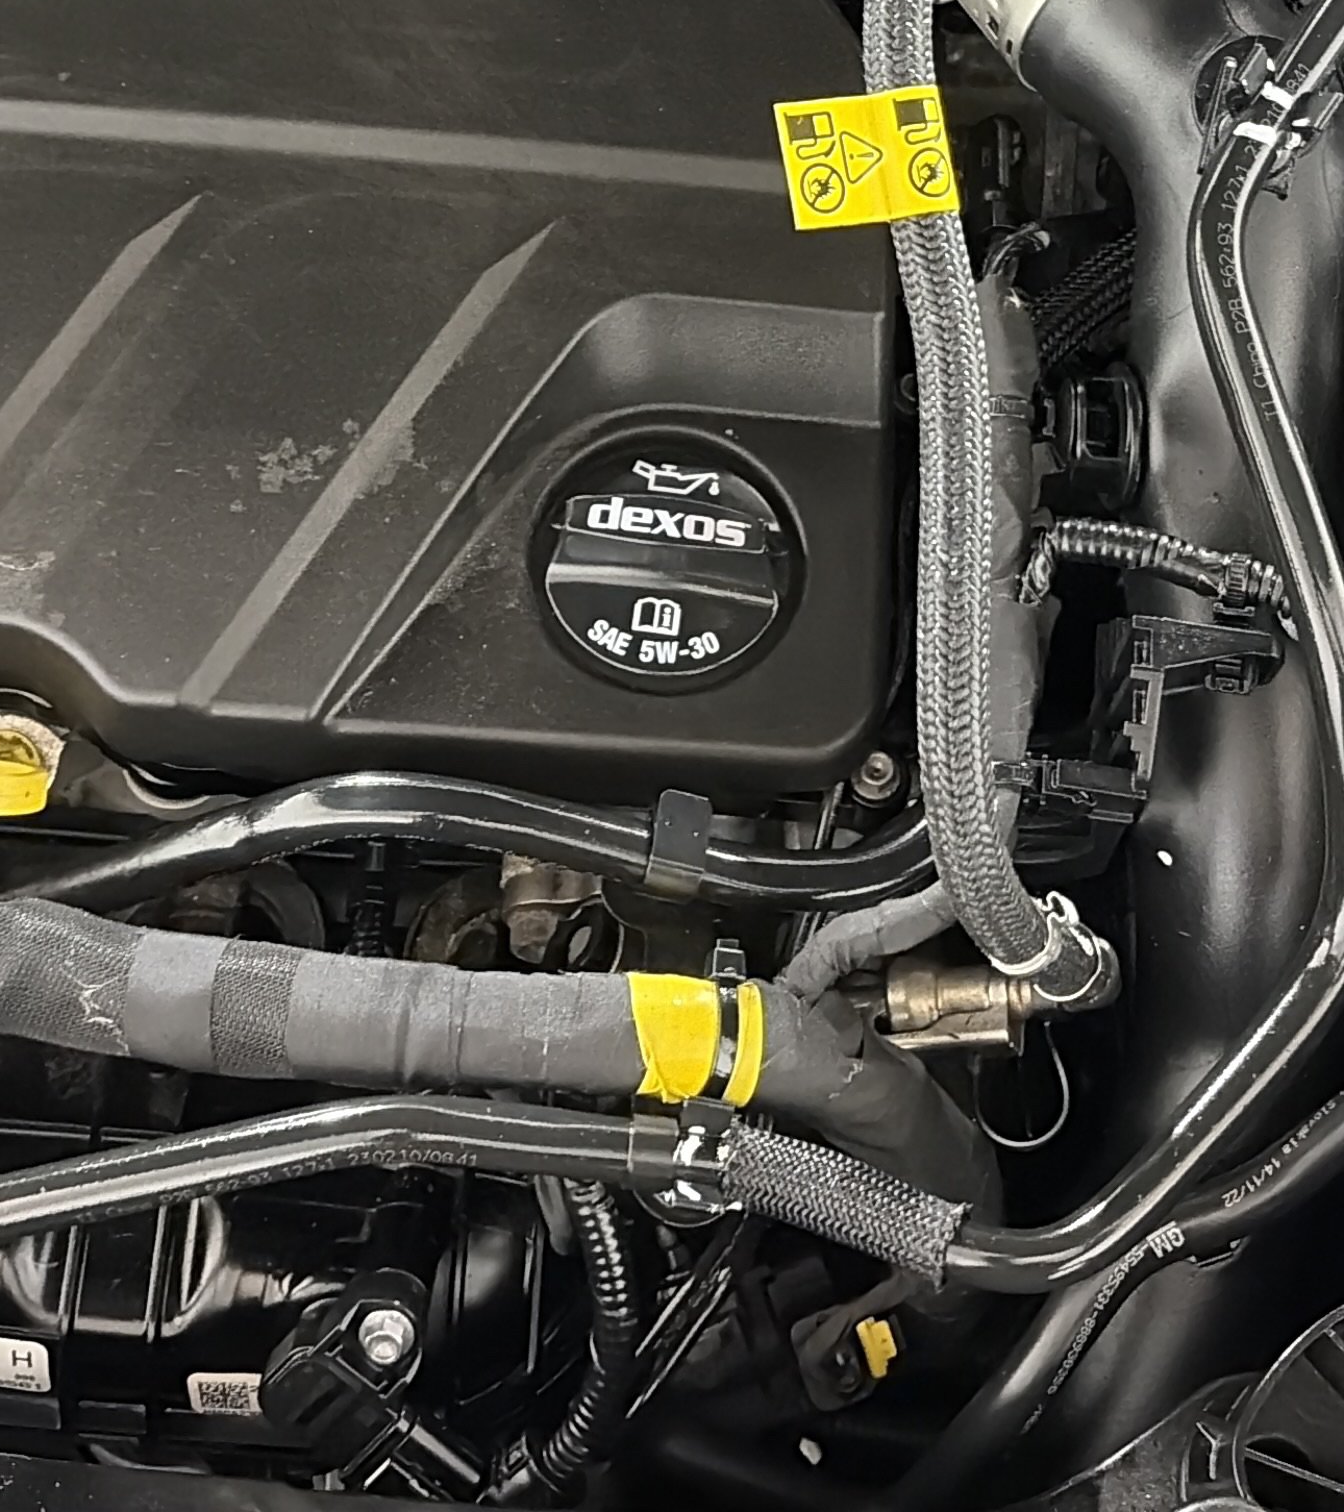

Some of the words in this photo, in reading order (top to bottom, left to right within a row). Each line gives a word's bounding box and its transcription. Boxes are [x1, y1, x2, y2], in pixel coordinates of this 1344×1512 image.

[587, 496, 752, 547] dexos
[587, 619, 633, 657] SAE
[638, 631, 721, 665] 5W-30
[1148, 1223, 1187, 1260] GM
[11, 1349, 32, 1368] H
